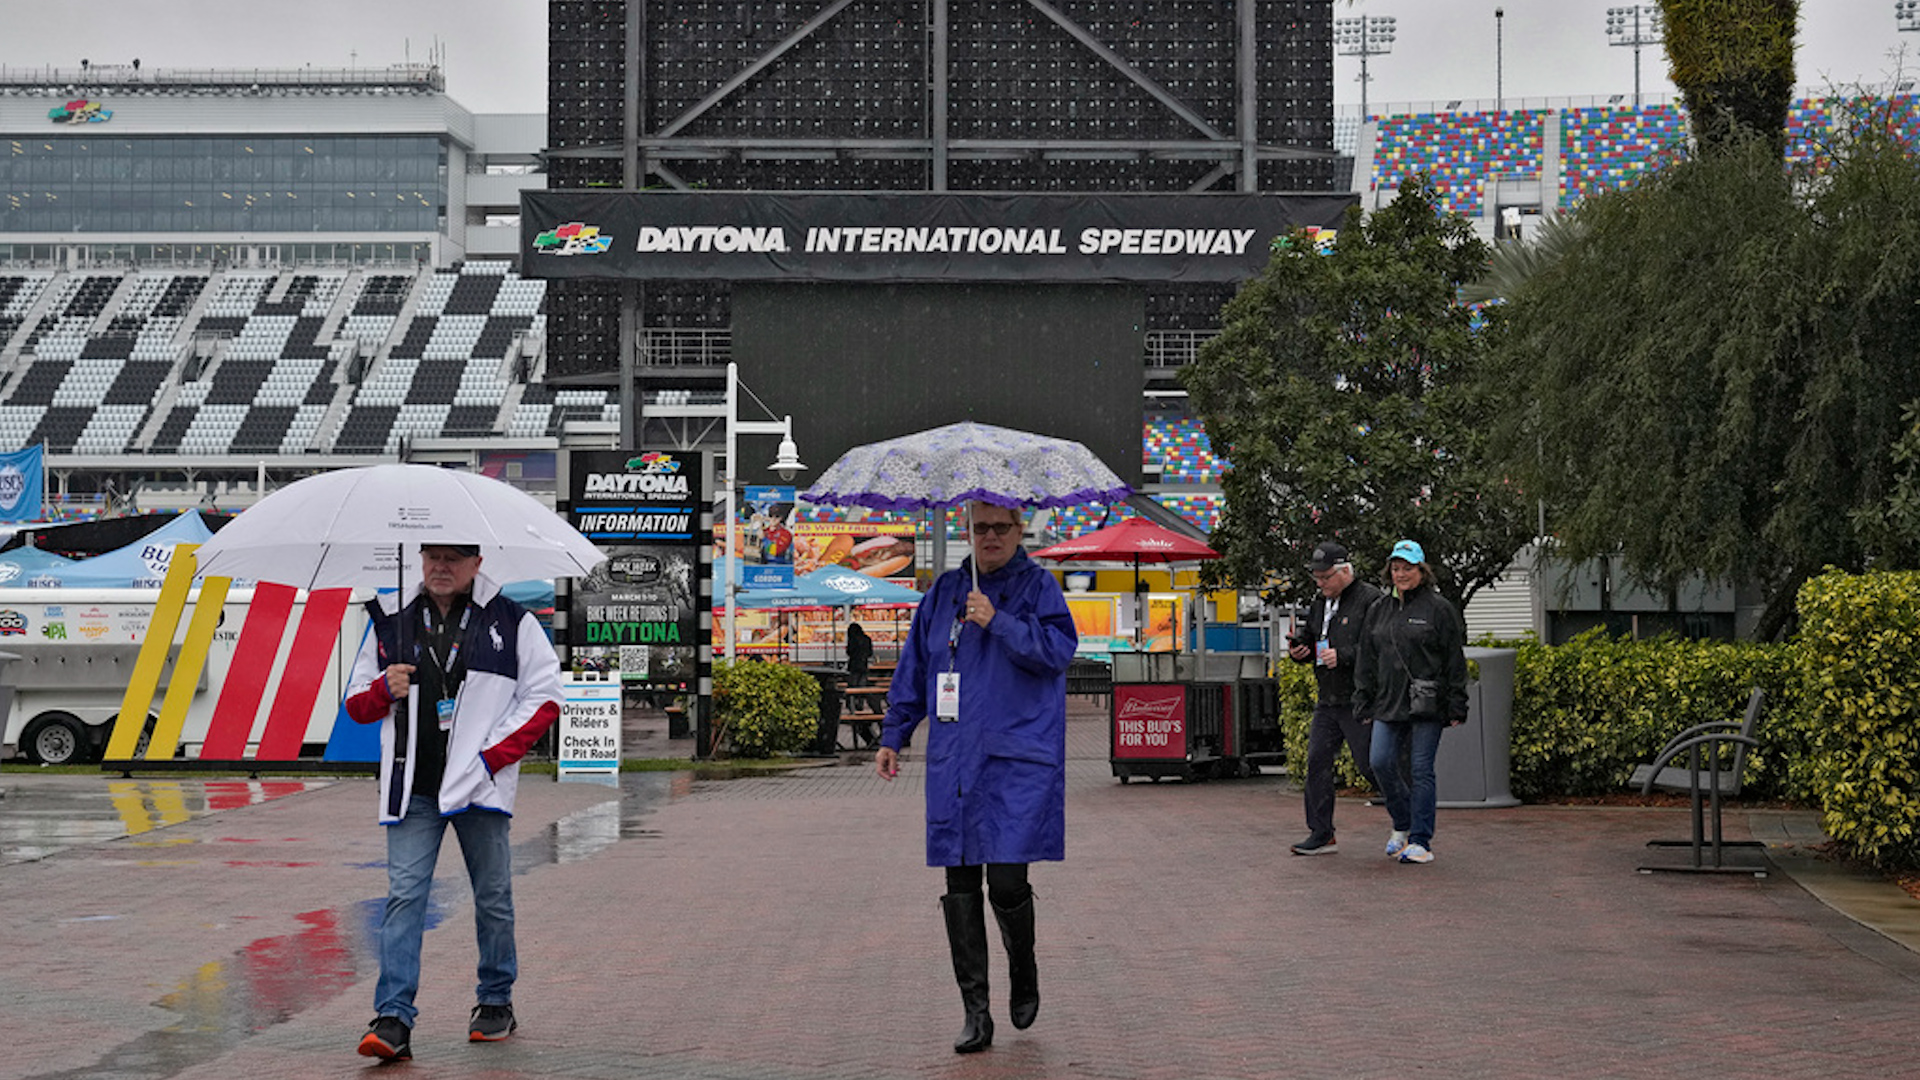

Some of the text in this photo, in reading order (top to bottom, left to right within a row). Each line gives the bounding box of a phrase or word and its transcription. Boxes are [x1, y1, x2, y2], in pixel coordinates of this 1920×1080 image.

[636, 226, 1256, 254] DAYTONA INTERNATIONAL SPEEDWAY
[585, 473, 689, 492] DAYTONA
[583, 492, 687, 500] INTERNATIONAL SPEEDWAY
[579, 515, 689, 532] INFORMATION
[754, 575, 783, 583] GORDON
[587, 605, 605, 622] BIKE
[606, 605, 628, 622] WEEK
[629, 605, 668, 622] RETURNS
[213, 632, 238, 640] ESTIC
[586, 622, 681, 643] DAYTONA
[562, 704, 618, 716] Drivers &
[570, 717, 609, 728] Riders
[1119, 720, 1182, 733] THIS BUD'S
[564, 736, 615, 747] Check In
[1120, 733, 1168, 746] FOR YOU
[572, 748, 587, 758] Pit
[590, 748, 616, 758] Road
